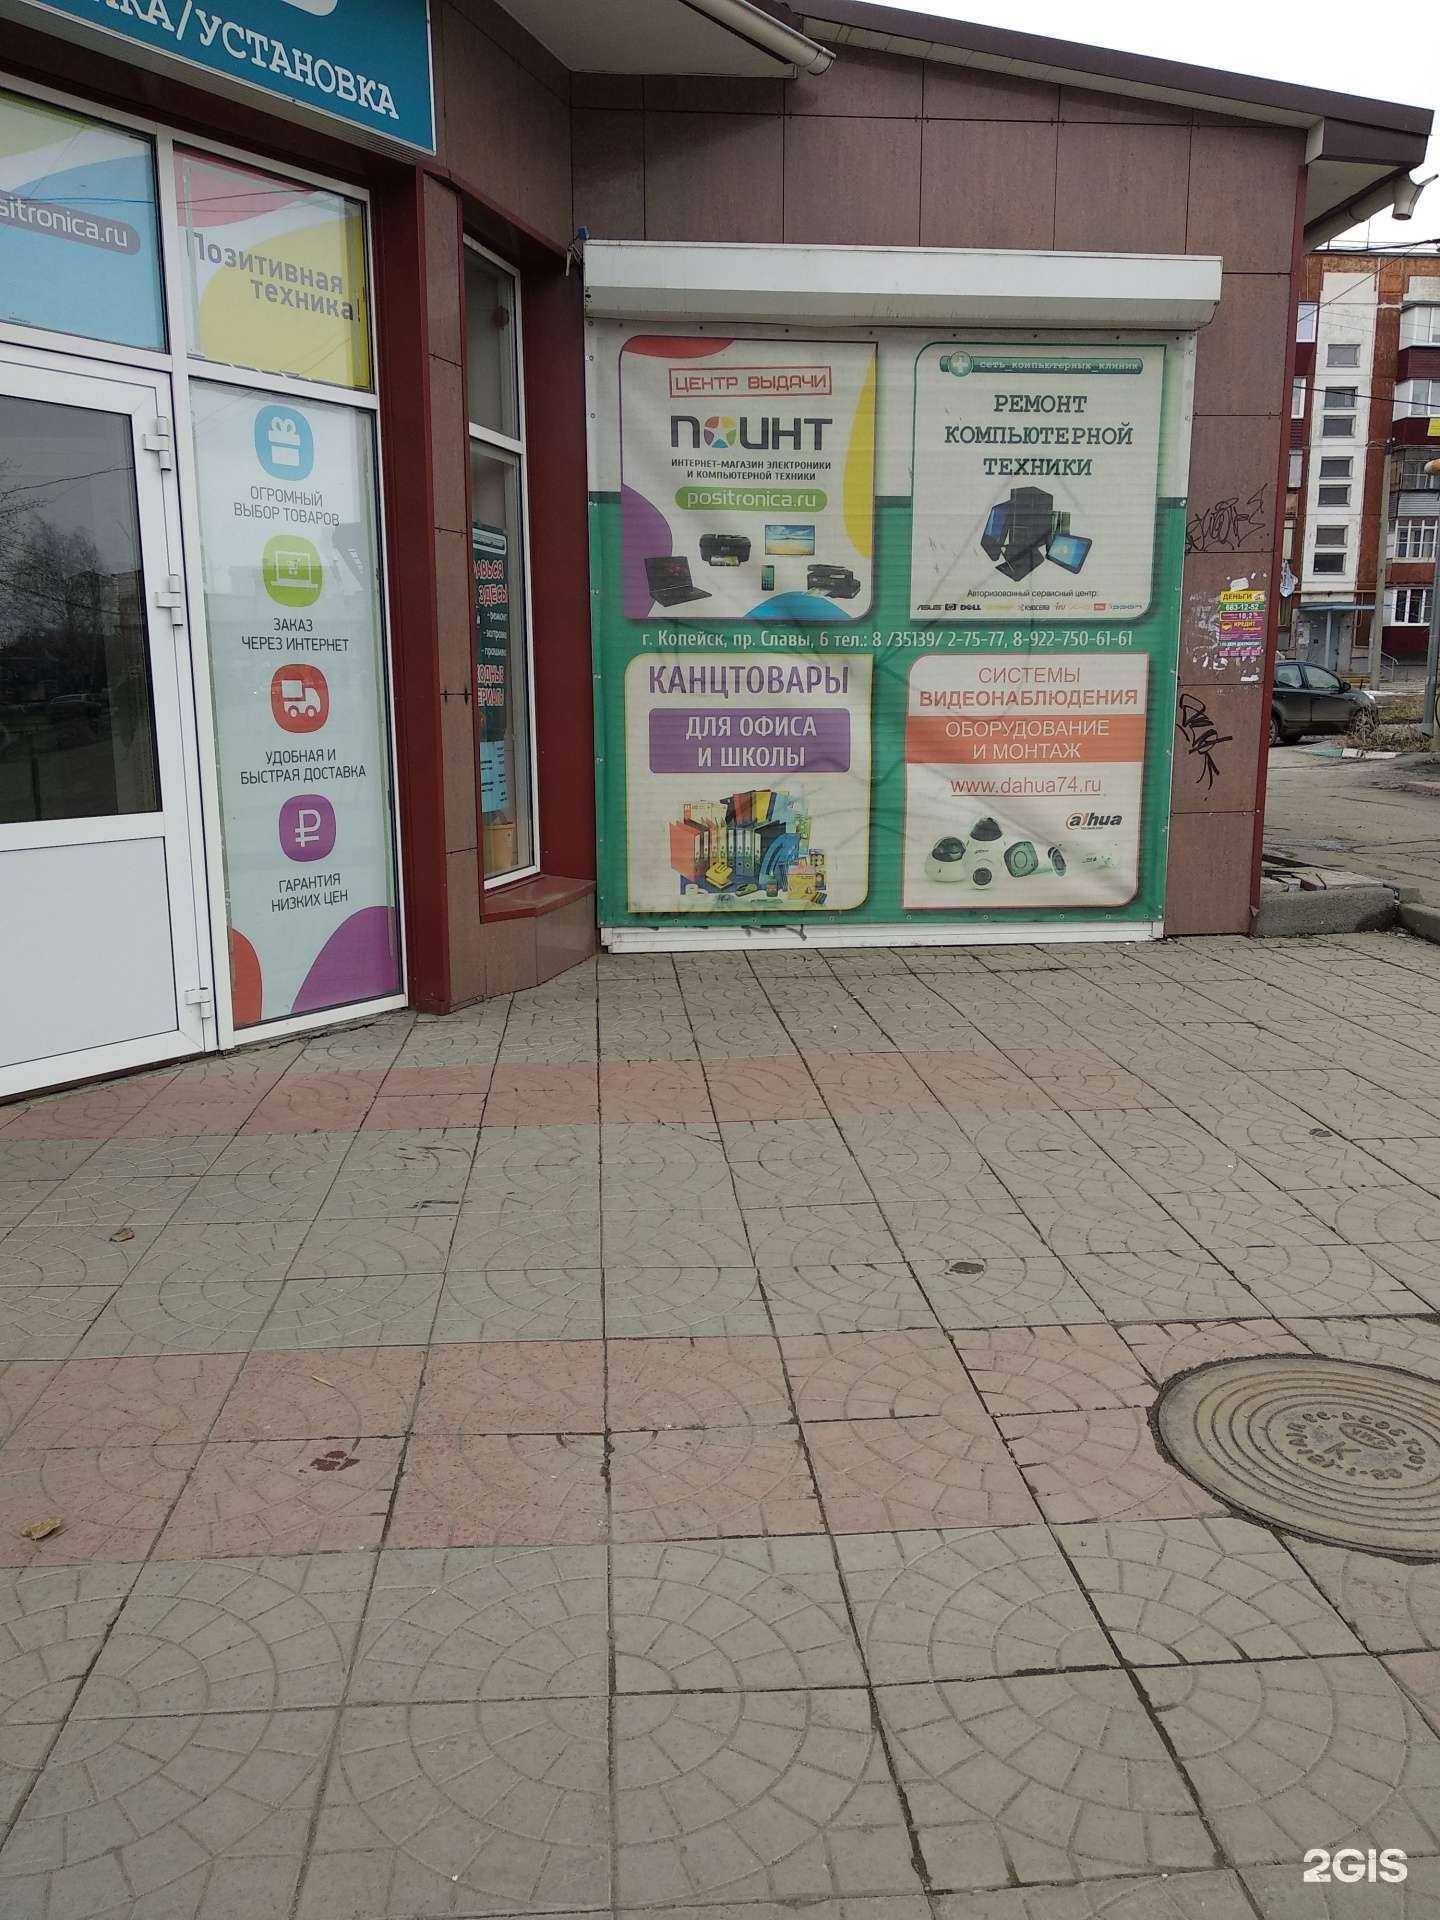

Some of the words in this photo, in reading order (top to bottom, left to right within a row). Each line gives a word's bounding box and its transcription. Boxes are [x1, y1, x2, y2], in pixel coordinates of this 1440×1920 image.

[675, 376, 739, 392] ЦЕНТР
[748, 374, 827, 390] ВЫДАЧИ
[993, 395, 1088, 413] РЕМОНТ
[945, 422, 1133, 445] КОМПЬЮТЕРНОЙ
[671, 459, 764, 470] ИНТЕРНЕТ-МАГАЗИН
[766, 461, 831, 470] ЭЛЕКТРОНИКИ
[983, 458, 1092, 476] ТЕХНИКИ
[687, 471, 693, 479] И
[696, 468, 773, 480] КОМПЬЮТЕРНОЙ
[775, 472, 816, 481] ТЕХНИКИ
[250, 486, 323, 508] ОГРОМНЫЙ
[687, 489, 817, 508] positronica.ru
[234, 502, 280, 519] ВЫБОР
[283, 507, 340, 526] ТОВАРОВ
[273, 618, 313, 632] ЗАКАЗ
[241, 636, 283, 650] ЧЕРЕЗ
[286, 637, 349, 651] ИНТЕРНЕТ
[642, 634, 651, 647] г.
[658, 631, 727, 648] Копейск,
[734, 635, 755, 650] пр.
[761, 631, 814, 649] Славы,
[820, 632, 828, 647] 6
[834, 634, 867, 647] тел.:
[872, 632, 881, 647] 8
[887, 631, 944, 648] /35139/
[948, 632, 1008, 649] 2-75-77,
[1012, 631, 1133, 647] 8-922-750-61-61
[650, 665, 849, 698] КАНЦТОВАРЫ
[978, 667, 1080, 684] СИСТЕМЫ
[919, 689, 1138, 709] ВИДЕОНАБЛЮДЕНИЯ
[686, 717, 731, 740] ДЛЯ
[739, 716, 817, 738] ОФИСА
[945, 720, 1110, 739] ОБОРУДОВАНИЕ
[265, 749, 324, 766] УДОБНАЯ
[328, 749, 336, 761] И
[698, 747, 712, 767] И
[720, 747, 805, 767] ШКОЛЫ
[973, 744, 985, 760] И
[993, 743, 1081, 760] МОНТАЖ
[240, 768, 300, 785] БЫСТРАЯ
[303, 765, 367, 783] ДОСТАВКА
[950, 776, 1101, 794] www.dahua74.ru
[279, 873, 341, 893] ГАРАНТИЯ
[271, 894, 321, 912] НИЗКИХ
[324, 889, 348, 906] ЦЕН
